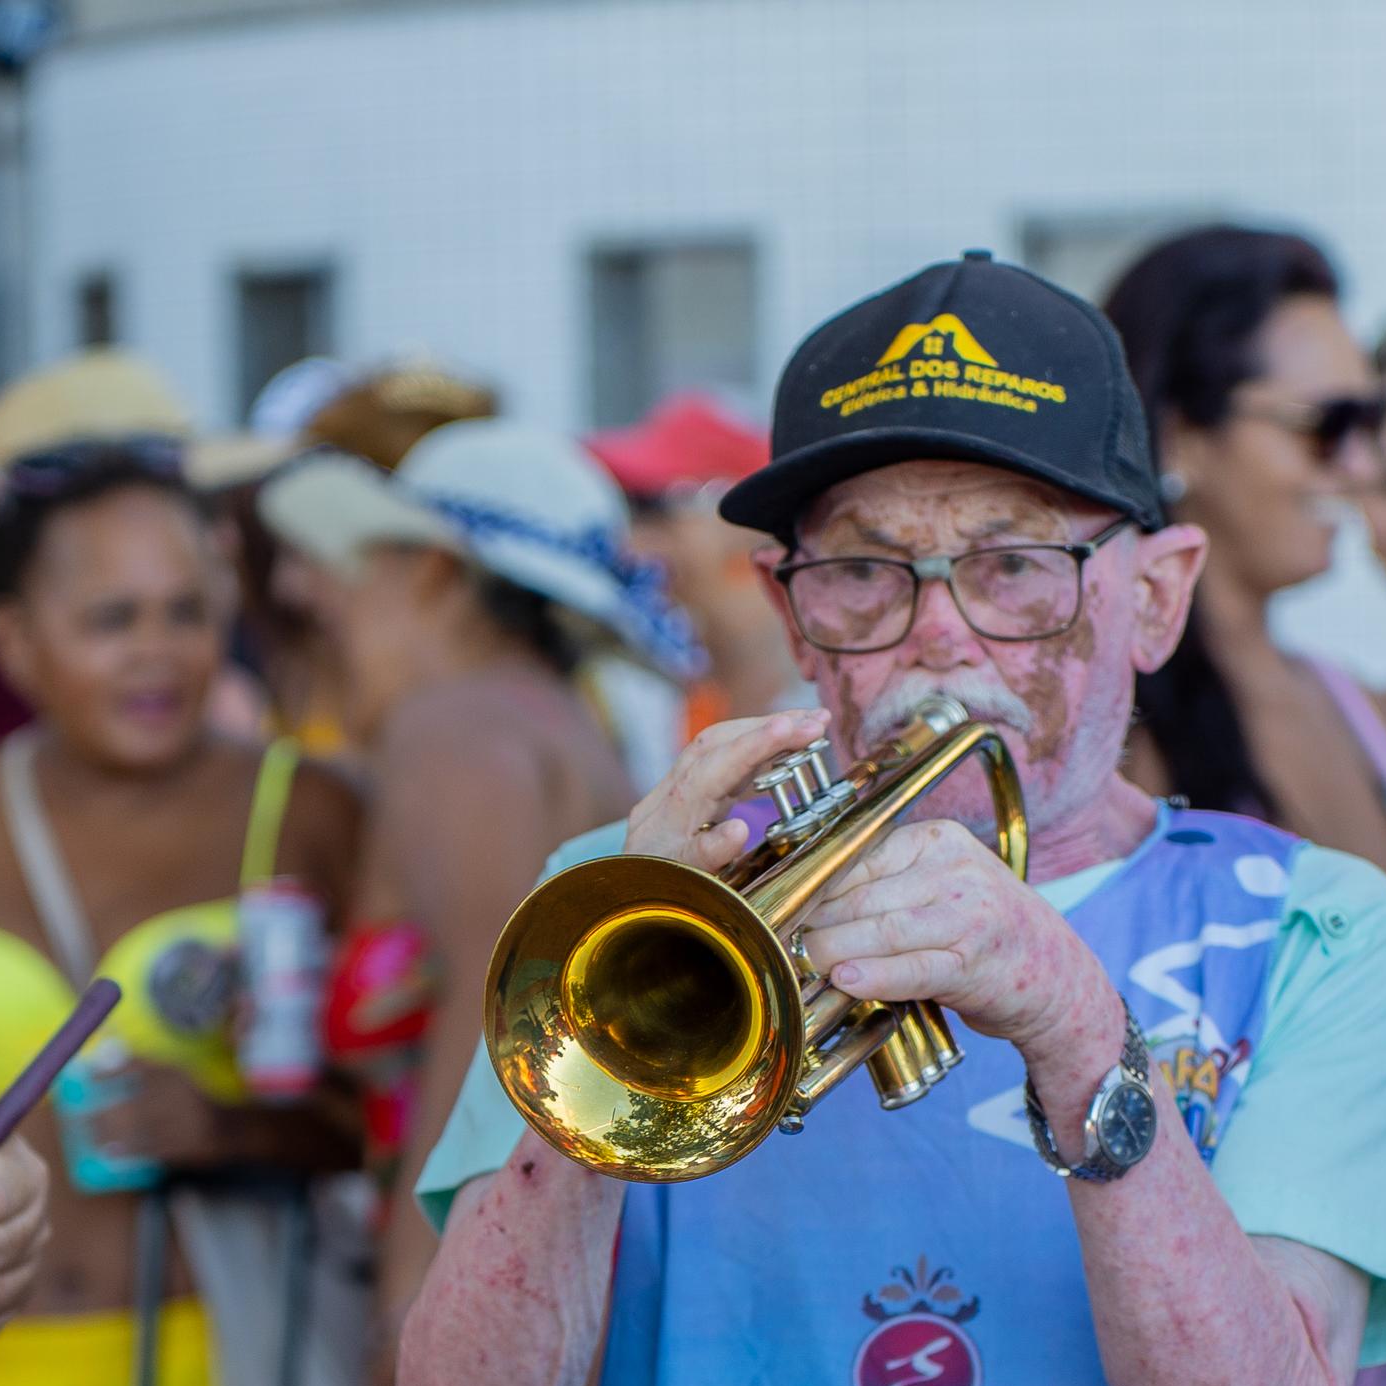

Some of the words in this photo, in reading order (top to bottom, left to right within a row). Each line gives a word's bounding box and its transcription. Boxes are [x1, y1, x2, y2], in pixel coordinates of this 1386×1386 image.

[821, 363, 906, 409] CENTRAL
[909, 359, 960, 379] DOS
[964, 363, 1067, 404] REPAROS
[910, 380, 930, 398] &
